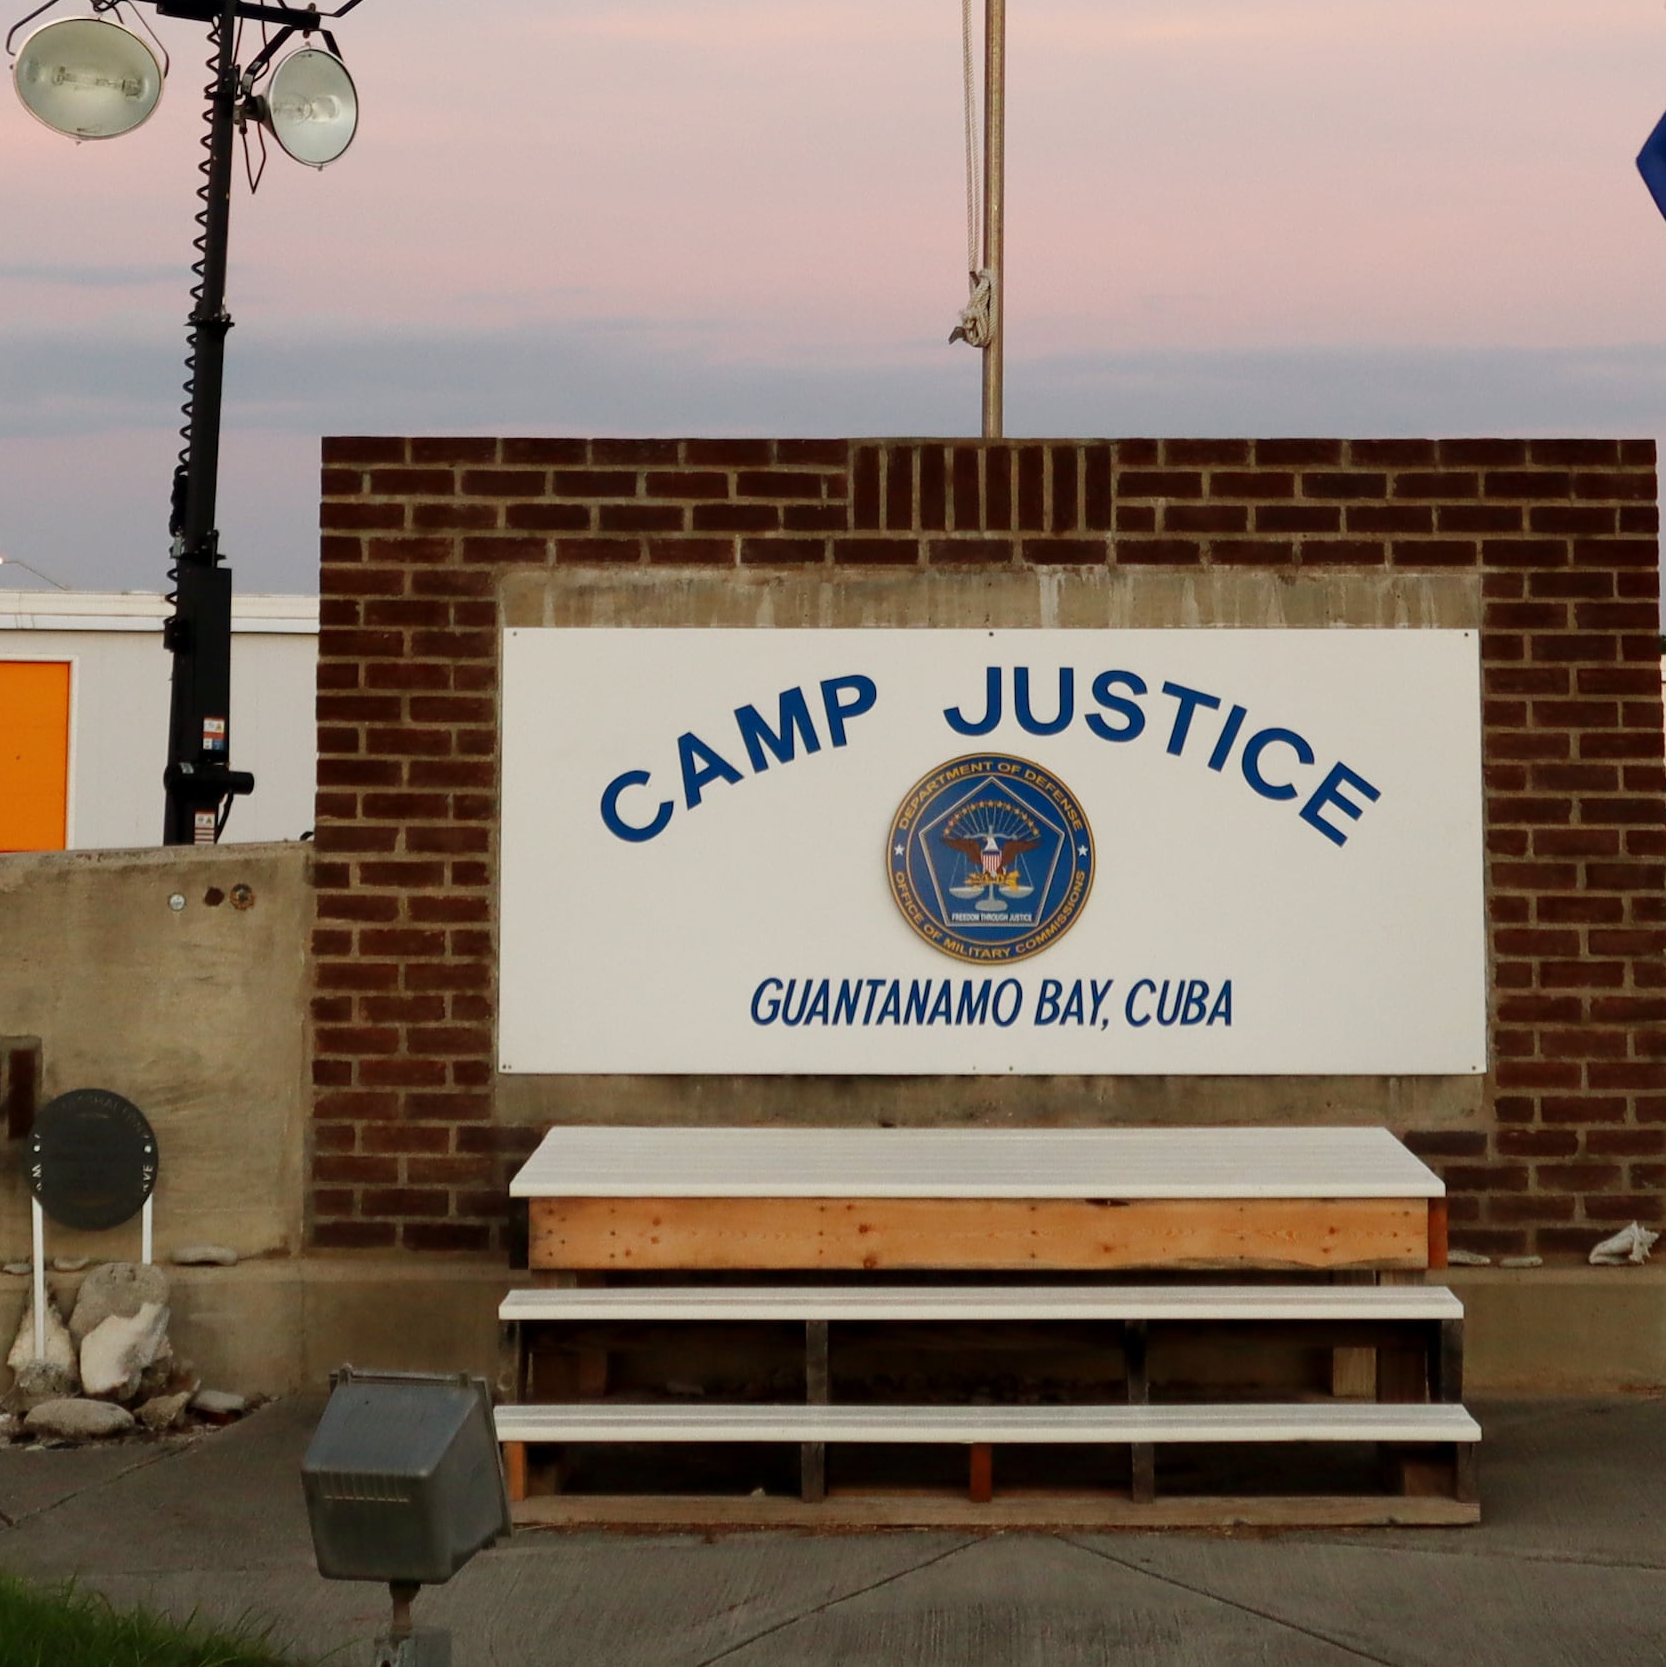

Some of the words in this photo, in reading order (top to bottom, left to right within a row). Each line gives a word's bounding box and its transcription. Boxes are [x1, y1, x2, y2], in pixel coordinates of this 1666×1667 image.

[600, 674, 877, 843] CAMP
[943, 666, 1381, 847] JUSTICE
[899, 761, 993, 830] DEPARTMENT
[997, 762, 1022, 774] OF
[1024, 769, 1083, 832] DEFENSE
[895, 871, 924, 925] OFFICE
[923, 923, 942, 940] OF
[943, 938, 1011, 959] MILITARY
[1015, 870, 1085, 953] COMMISSIONS
[749, 977, 1024, 1028] GUANTANAMO
[1034, 979, 1111, 1032] BAY,
[1124, 978, 1234, 1027] CUBA
